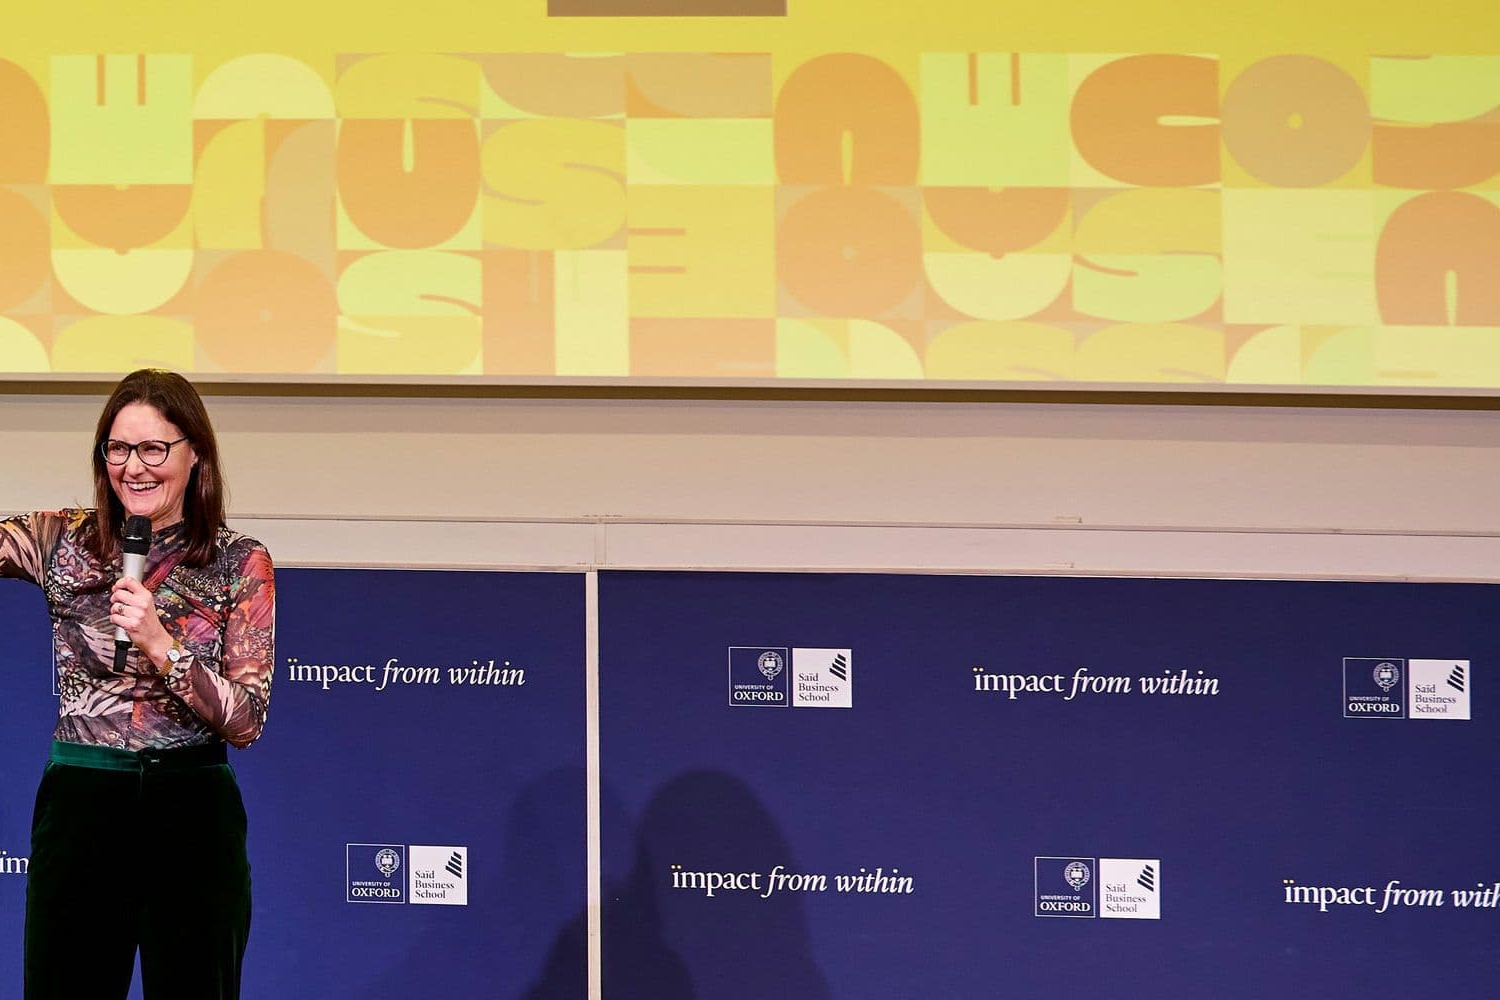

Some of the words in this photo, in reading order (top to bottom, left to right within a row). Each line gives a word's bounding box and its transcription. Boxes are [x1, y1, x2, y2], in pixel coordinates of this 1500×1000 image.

[375, 658, 440, 691] from
[447, 660, 525, 685] within
[799, 683, 839, 692] Business
[1063, 668, 1131, 700] from
[1138, 670, 1219, 695] within
[734, 692, 783, 700] OXFORD
[799, 693, 829, 701] School
[1348, 703, 1399, 713] OXFORD
[1415, 705, 1447, 713] School
[415, 880, 454, 889] Business
[760, 866, 827, 898] from
[835, 868, 914, 893] within
[352, 888, 400, 897] OXFORD
[415, 890, 446, 898] School
[1375, 881, 1444, 913] from
[1106, 894, 1146, 903] Business
[1040, 902, 1090, 911] OXFORD
[1106, 904, 1137, 913] School
